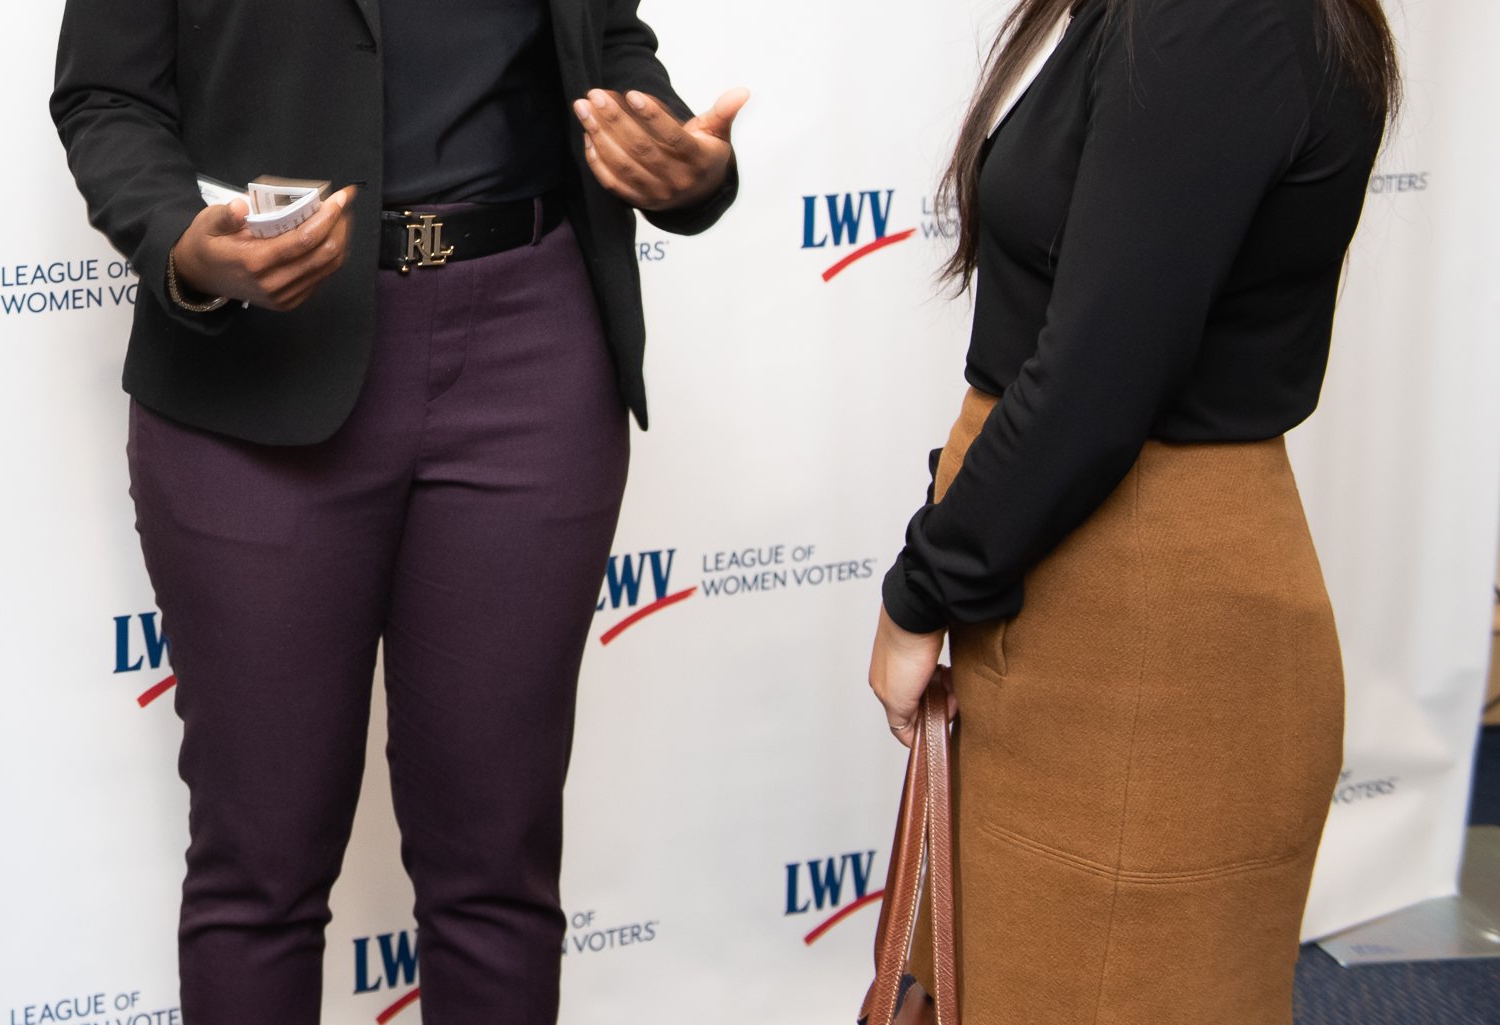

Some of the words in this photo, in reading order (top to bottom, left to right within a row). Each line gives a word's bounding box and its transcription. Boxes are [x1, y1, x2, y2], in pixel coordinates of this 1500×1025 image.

[801, 189, 895, 250] LWV
[1, 259, 99, 287] LEAGUE
[1, 285, 103, 315] WOMEN
[702, 545, 785, 574] LEAGUE
[791, 545, 814, 563] OF
[701, 570, 787, 598] WOMEN
[793, 559, 873, 587] VOTERS
[784, 849, 877, 918] LWV
[571, 911, 596, 929] OF
[572, 922, 656, 954] VOTERS
[352, 930, 419, 995] LW
[114, 991, 141, 1012] OF
